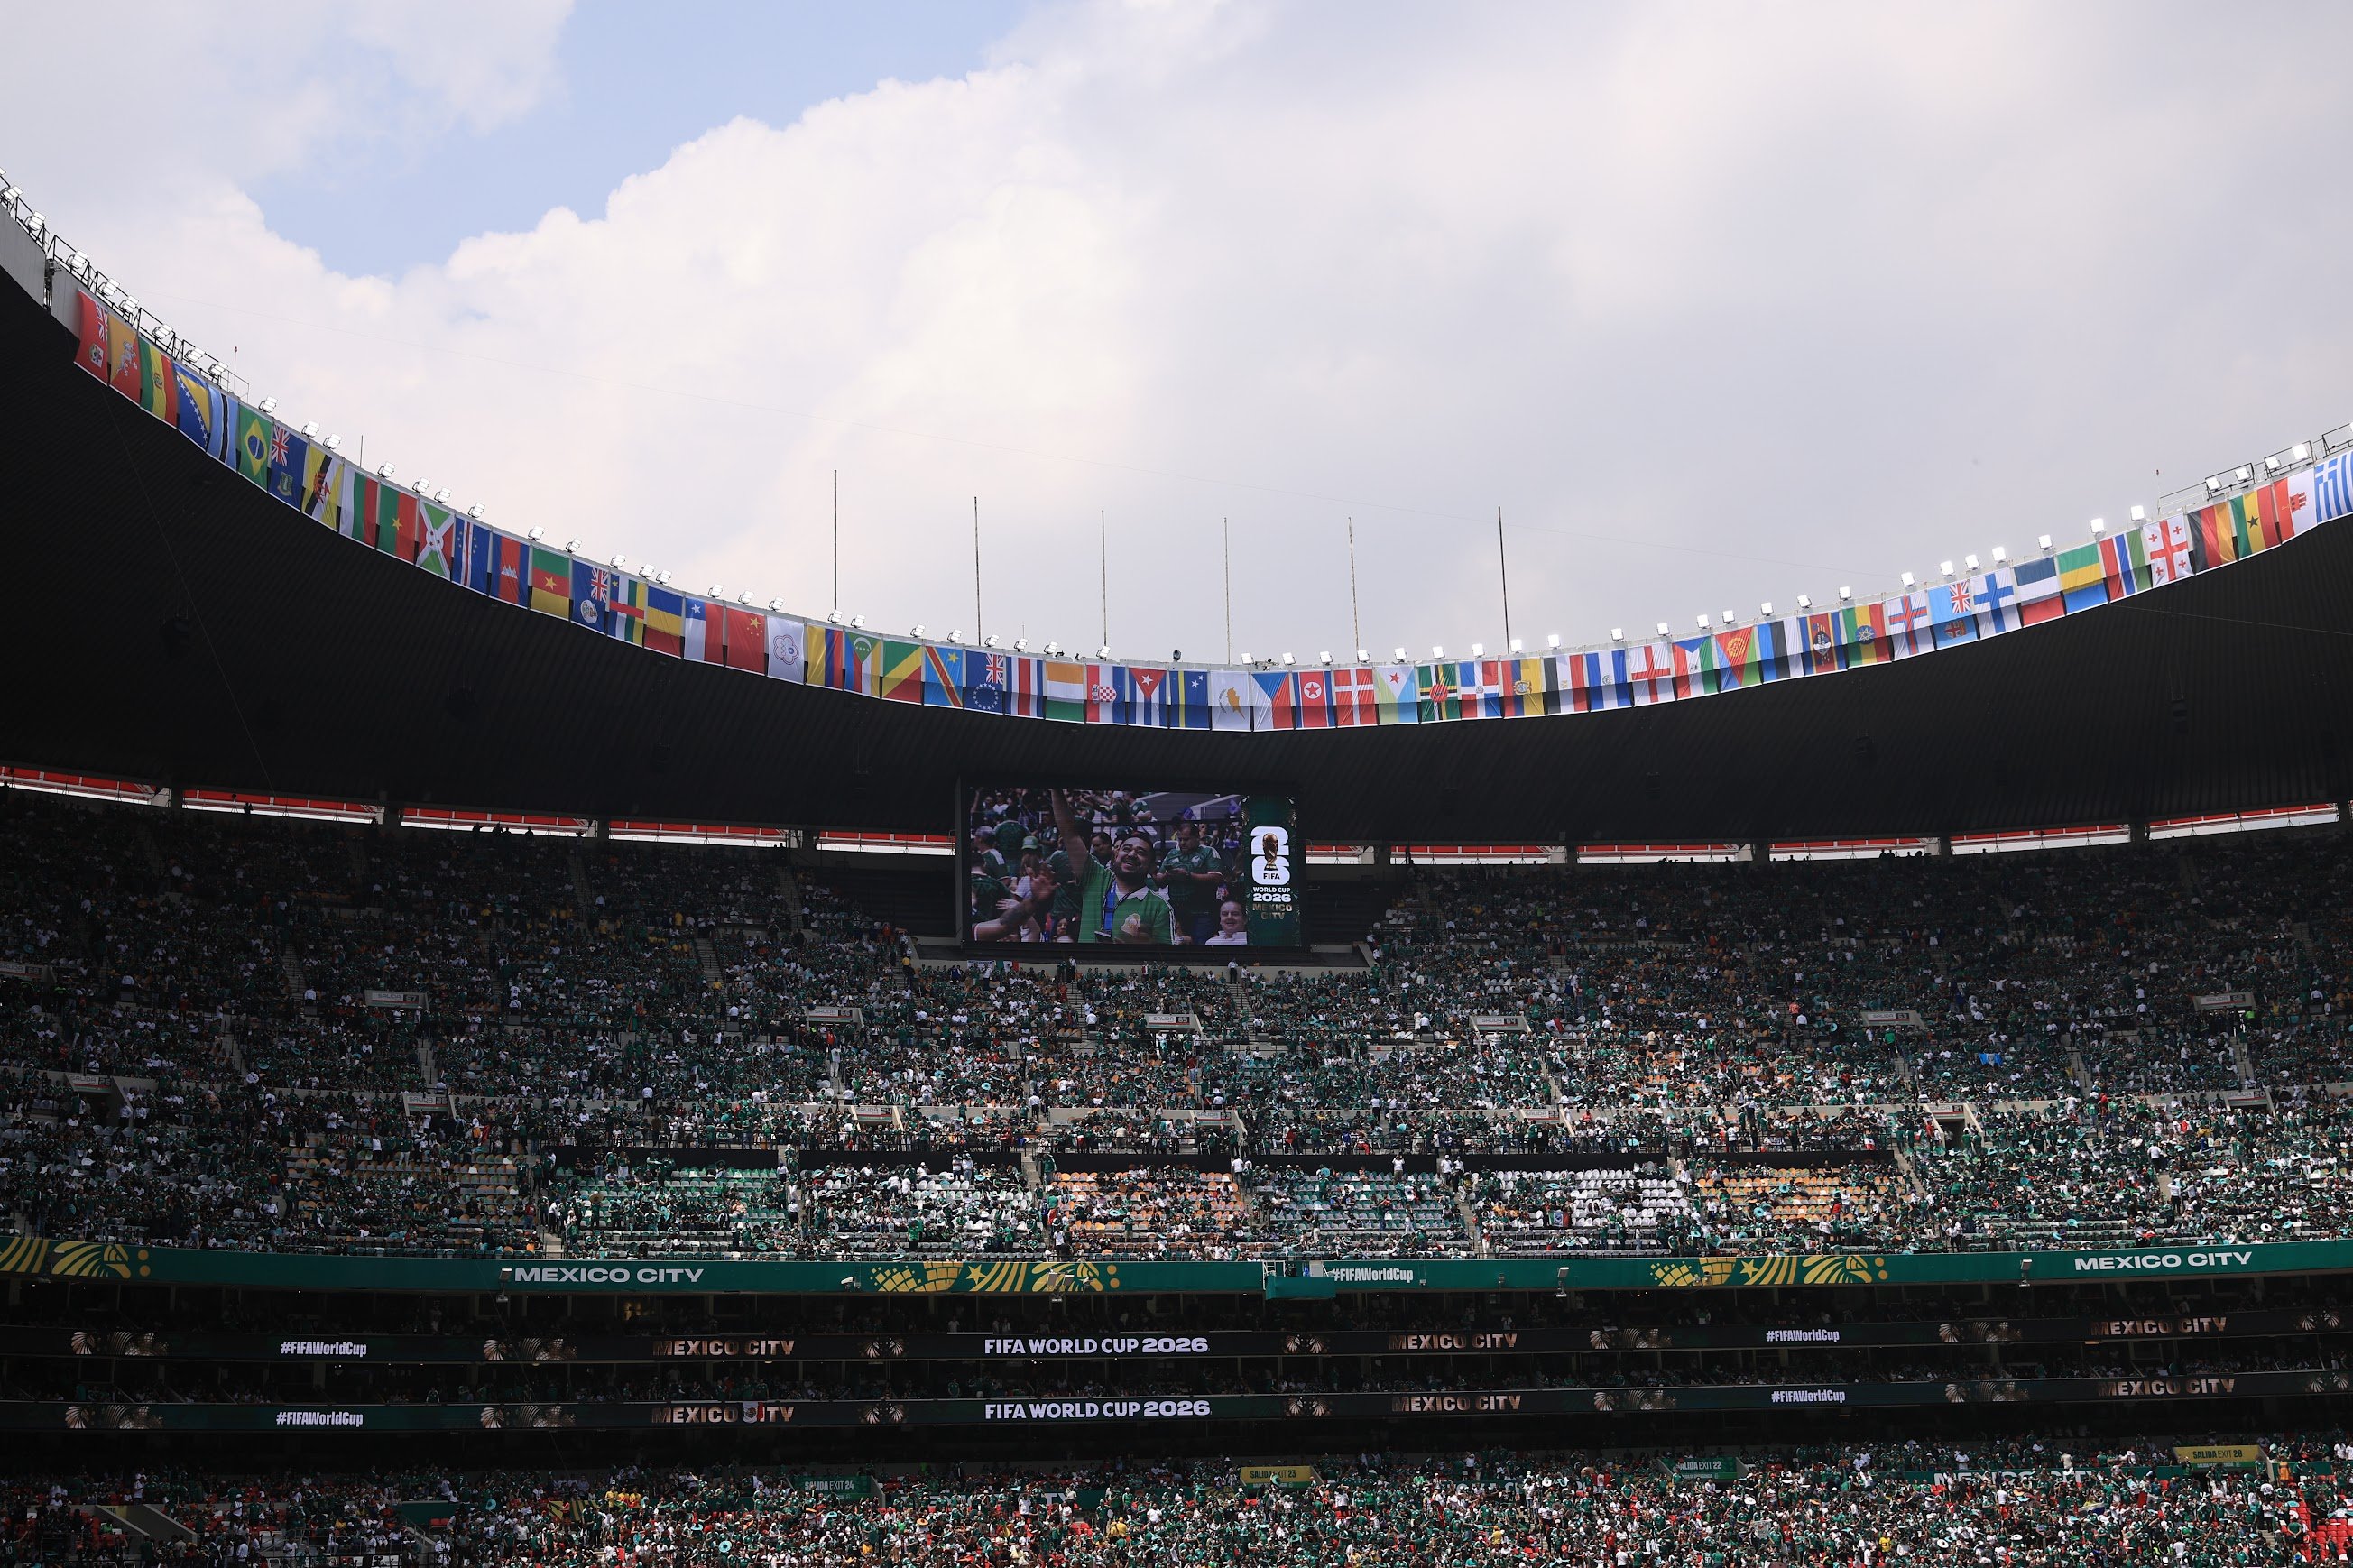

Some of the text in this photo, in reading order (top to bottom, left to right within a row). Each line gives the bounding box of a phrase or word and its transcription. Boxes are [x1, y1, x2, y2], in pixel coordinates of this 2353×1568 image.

[1253, 893, 1292, 902] 2026
[1252, 903, 1293, 911] MEXICO
[1260, 912, 1286, 920] CITY
[0, 963, 23, 971] SALIDA
[71, 1075, 97, 1084] SALIDA
[2075, 1252, 2253, 1271] MEXICO CITY
[514, 1268, 704, 1283] MEXICO CITY
[1333, 1268, 1414, 1283] #FIFAWorldCup
[2090, 1317, 2227, 1335] MEXICO CITY
[1388, 1334, 1518, 1350] MEXICO CITY
[1767, 1329, 1840, 1343] #FIFAWorldCup
[280, 1342, 367, 1358] #FIFAWorldCup
[652, 1340, 795, 1356] MEXICO CITY
[984, 1337, 1208, 1354] FIFA WORLD CUP 2026
[2098, 1379, 2235, 1396] MEXICO CITY
[1392, 1396, 1521, 1412] MEXICO CITY
[1771, 1390, 1846, 1404] #FIFAWorldCup
[651, 1406, 795, 1424] MEXICO ITY
[986, 1400, 1211, 1419] FIFA WORLD CUP 2026
[276, 1412, 364, 1427] #FIFAWorldCup
[2192, 1450, 2217, 1459] SALIDA
[2218, 1450, 2231, 1459] EXIT
[1699, 1461, 1712, 1470] EXIT
[1712, 1461, 1721, 1470] 22
[1250, 1471, 1272, 1479] SALIDA
[1287, 1470, 1296, 1478] 23
[805, 1480, 854, 1490] SALIDA EXIT 24
